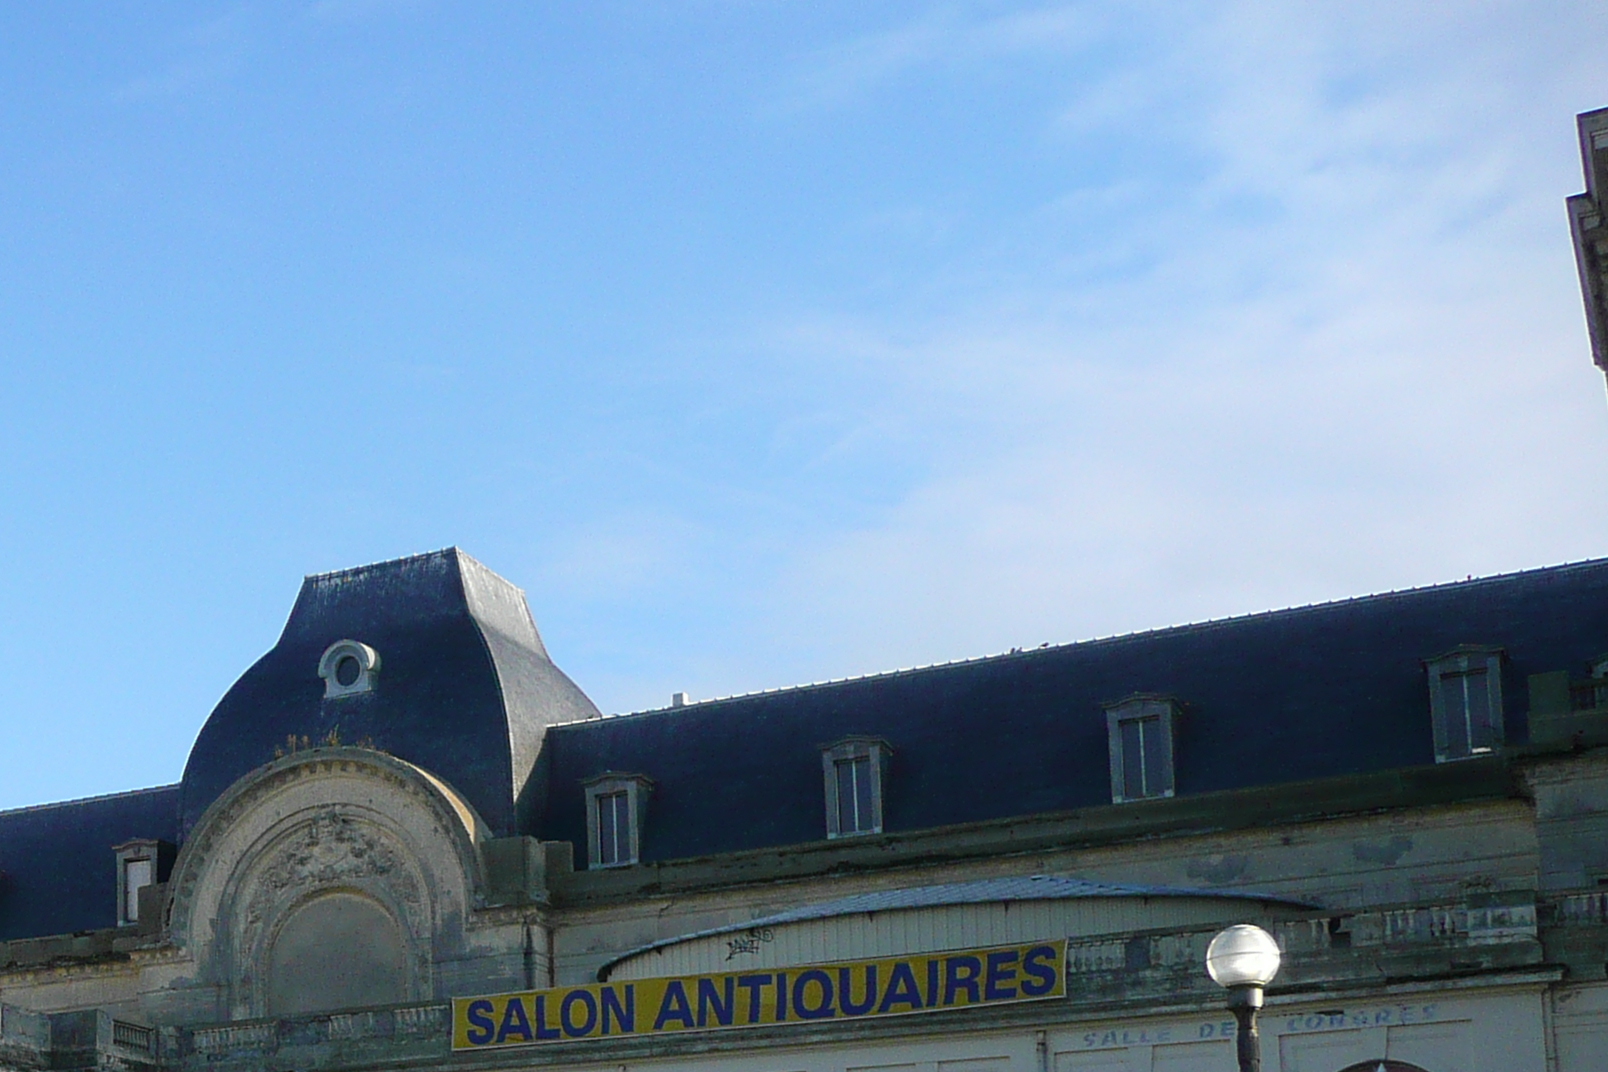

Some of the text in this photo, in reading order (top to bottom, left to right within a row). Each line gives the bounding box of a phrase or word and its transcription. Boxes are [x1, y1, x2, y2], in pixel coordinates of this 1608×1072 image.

[466, 946, 1059, 1046] SALON ANTIQUAIRES
[1083, 1029, 1171, 1048] SALLE
[1199, 1020, 1236, 1039] DE
